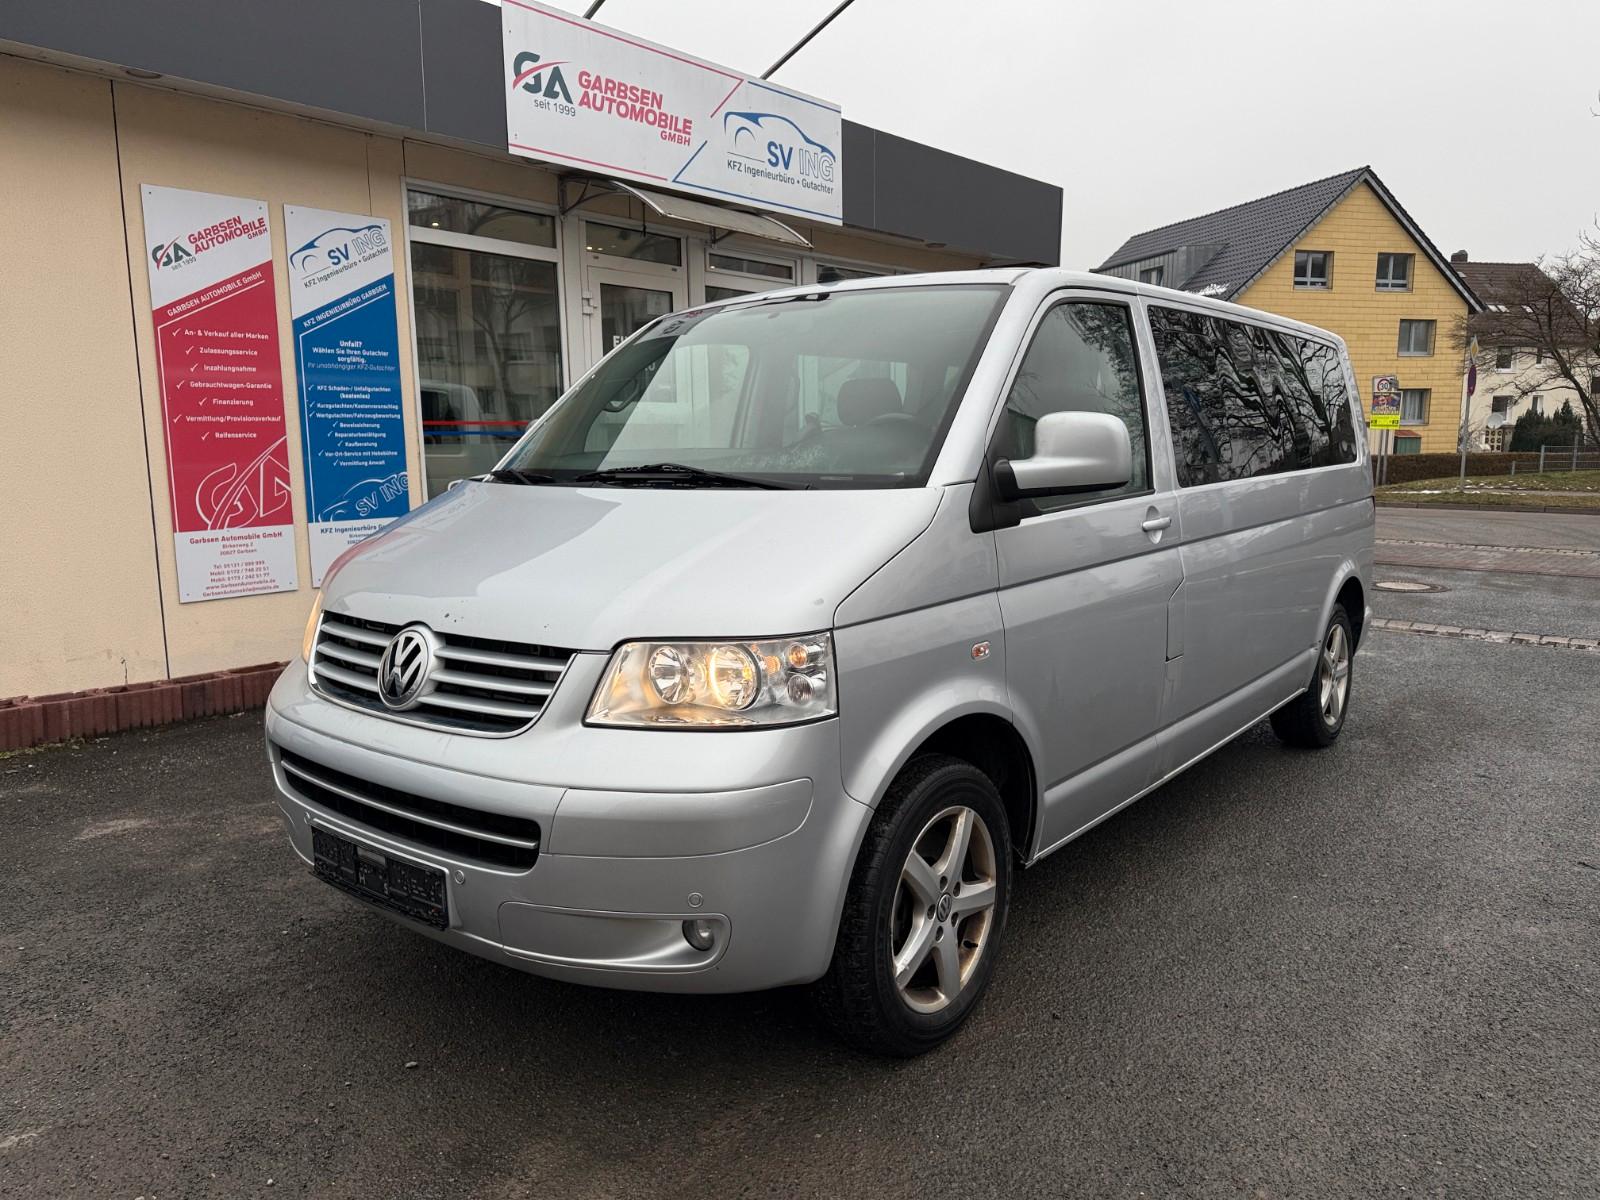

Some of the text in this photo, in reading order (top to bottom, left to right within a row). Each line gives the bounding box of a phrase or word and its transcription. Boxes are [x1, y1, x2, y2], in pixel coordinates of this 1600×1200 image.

[578, 70, 663, 110] GARBSEN
[534, 98, 576, 117] seit 1999
[578, 90, 693, 136] AUTOMOBILE
[660, 131, 691, 146] GMBH
[767, 140, 834, 183] SV ING
[727, 159, 834, 195] KFZ Ingenieurbüro Gutachter
[187, 215, 243, 245] GARBSEN
[194, 217, 266, 255] AUTOMOBILE
[247, 227, 268, 241] GMBH
[327, 228, 387, 266] SV ING
[182, 256, 197, 266] 1999
[303, 246, 389, 289] KFZ Ingenieurbüro Gutachter
[167, 271, 262, 317] GARBSEN AUTOMOBILE GmbH
[303, 283, 388, 328] KFZ INGENIEURBÜRO GARBSEN
[246, 332, 269, 340] Marken
[339, 340, 363, 348] Unfall?
[199, 347, 258, 356] Zulassungsservice
[312, 346, 335, 354] Wählen
[204, 364, 257, 373] Inzahlungnahme
[190, 381, 272, 390] Gebrauchtwagen-Garantie
[213, 398, 254, 406] Finanzierung
[355, 491, 379, 517] SV
[189, 531, 283, 545] Garbsen Automobile GmbH
